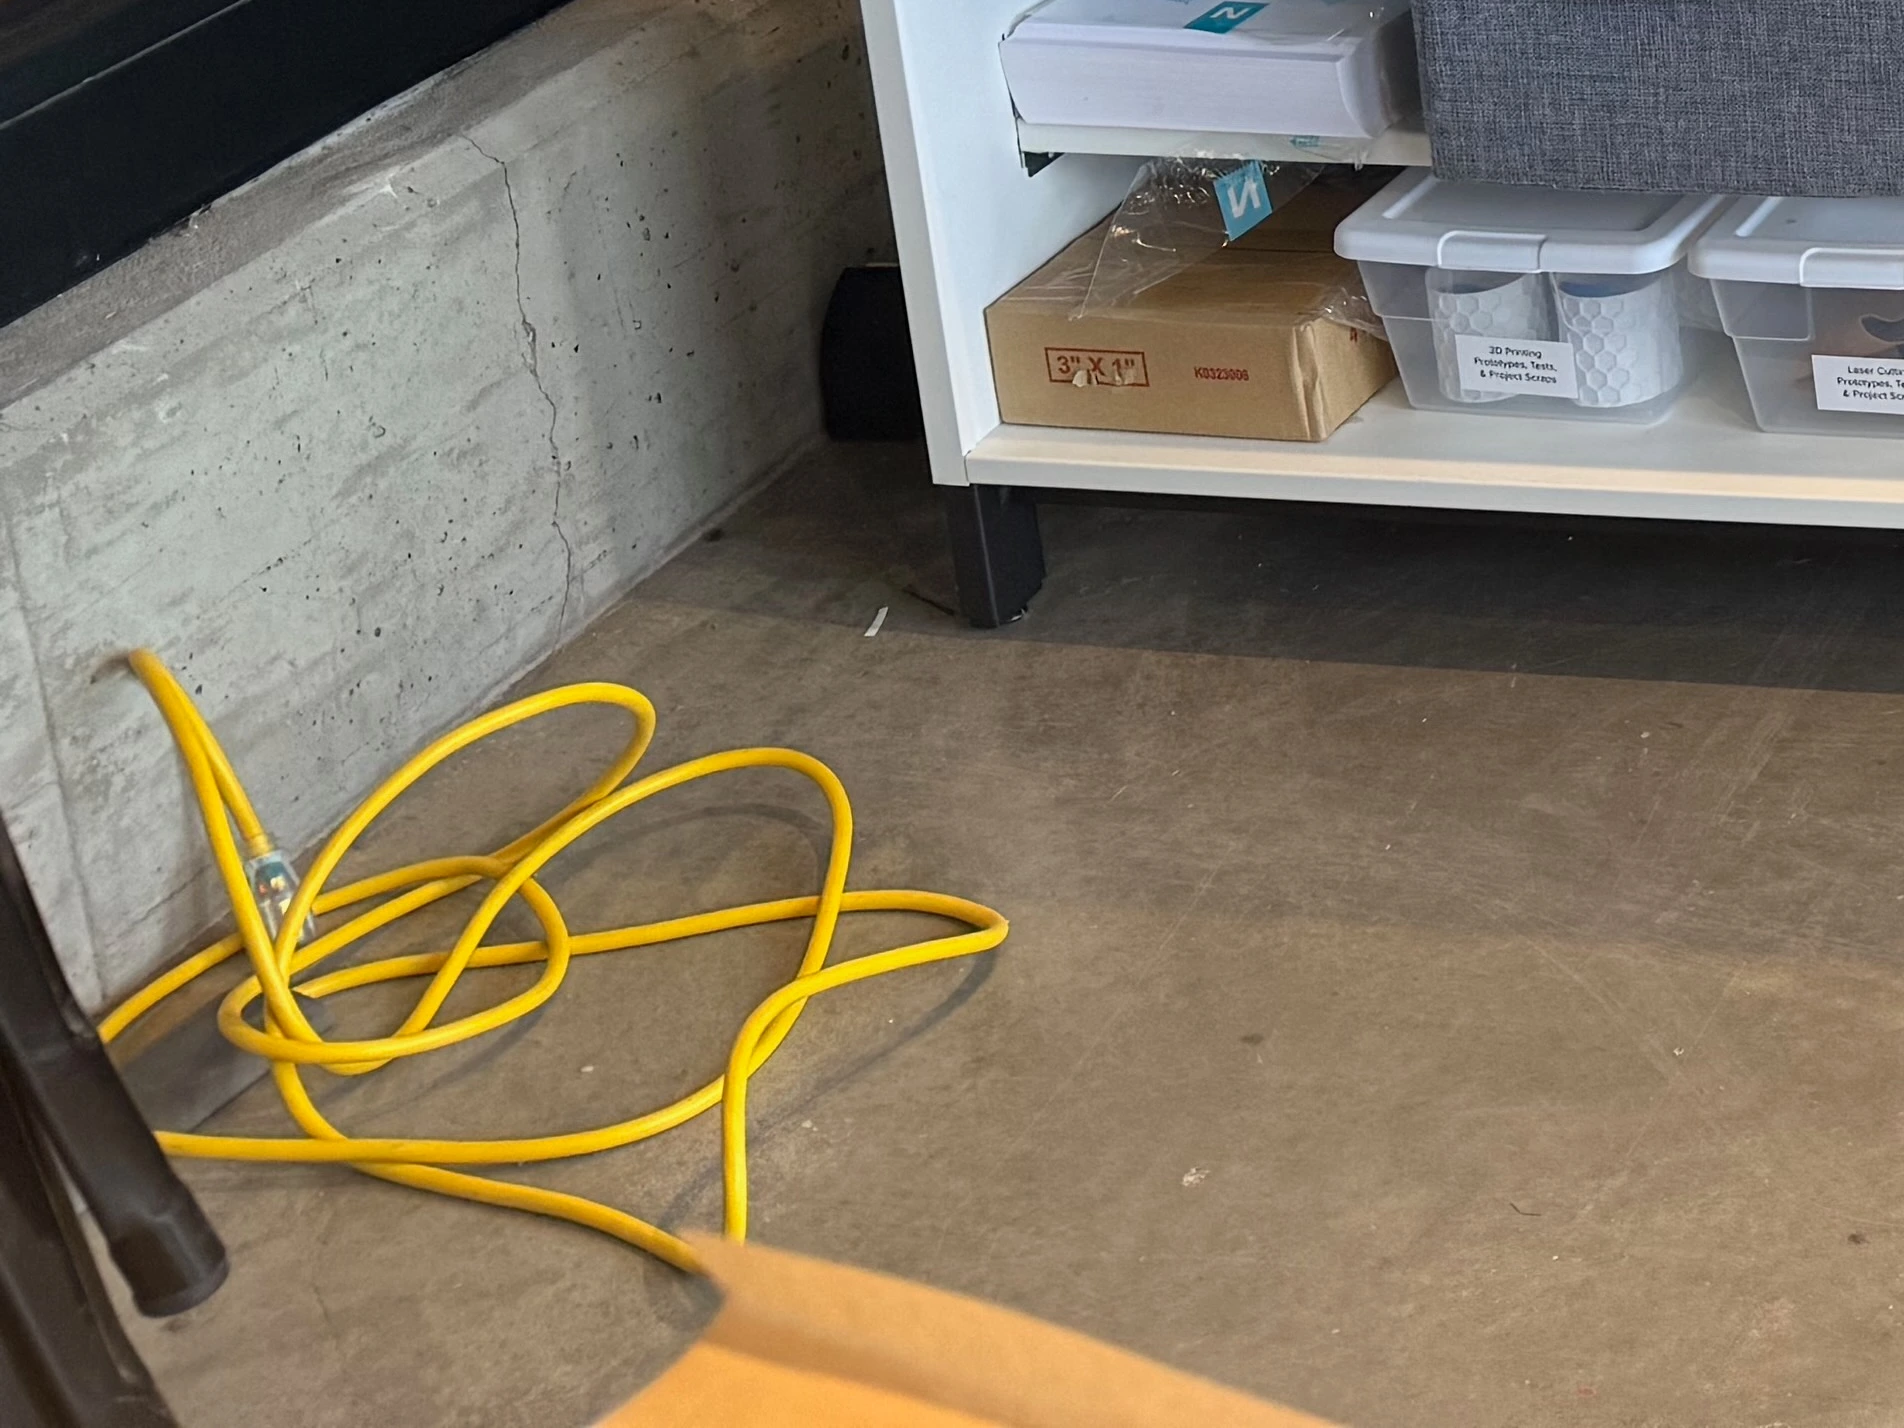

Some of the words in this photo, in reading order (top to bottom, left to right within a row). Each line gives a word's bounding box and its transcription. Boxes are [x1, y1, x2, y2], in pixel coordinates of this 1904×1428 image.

[1505, 347, 1542, 359] Printing
[1057, 355, 1081, 375] 3"
[1530, 361, 1557, 372] Tests,
[1848, 366, 1873, 374] Laser
[1489, 370, 1522, 382] Project
[1525, 373, 1557, 383] Scraps
[1837, 377, 1892, 388] Prototypes,
[1853, 390, 1887, 400] Project
